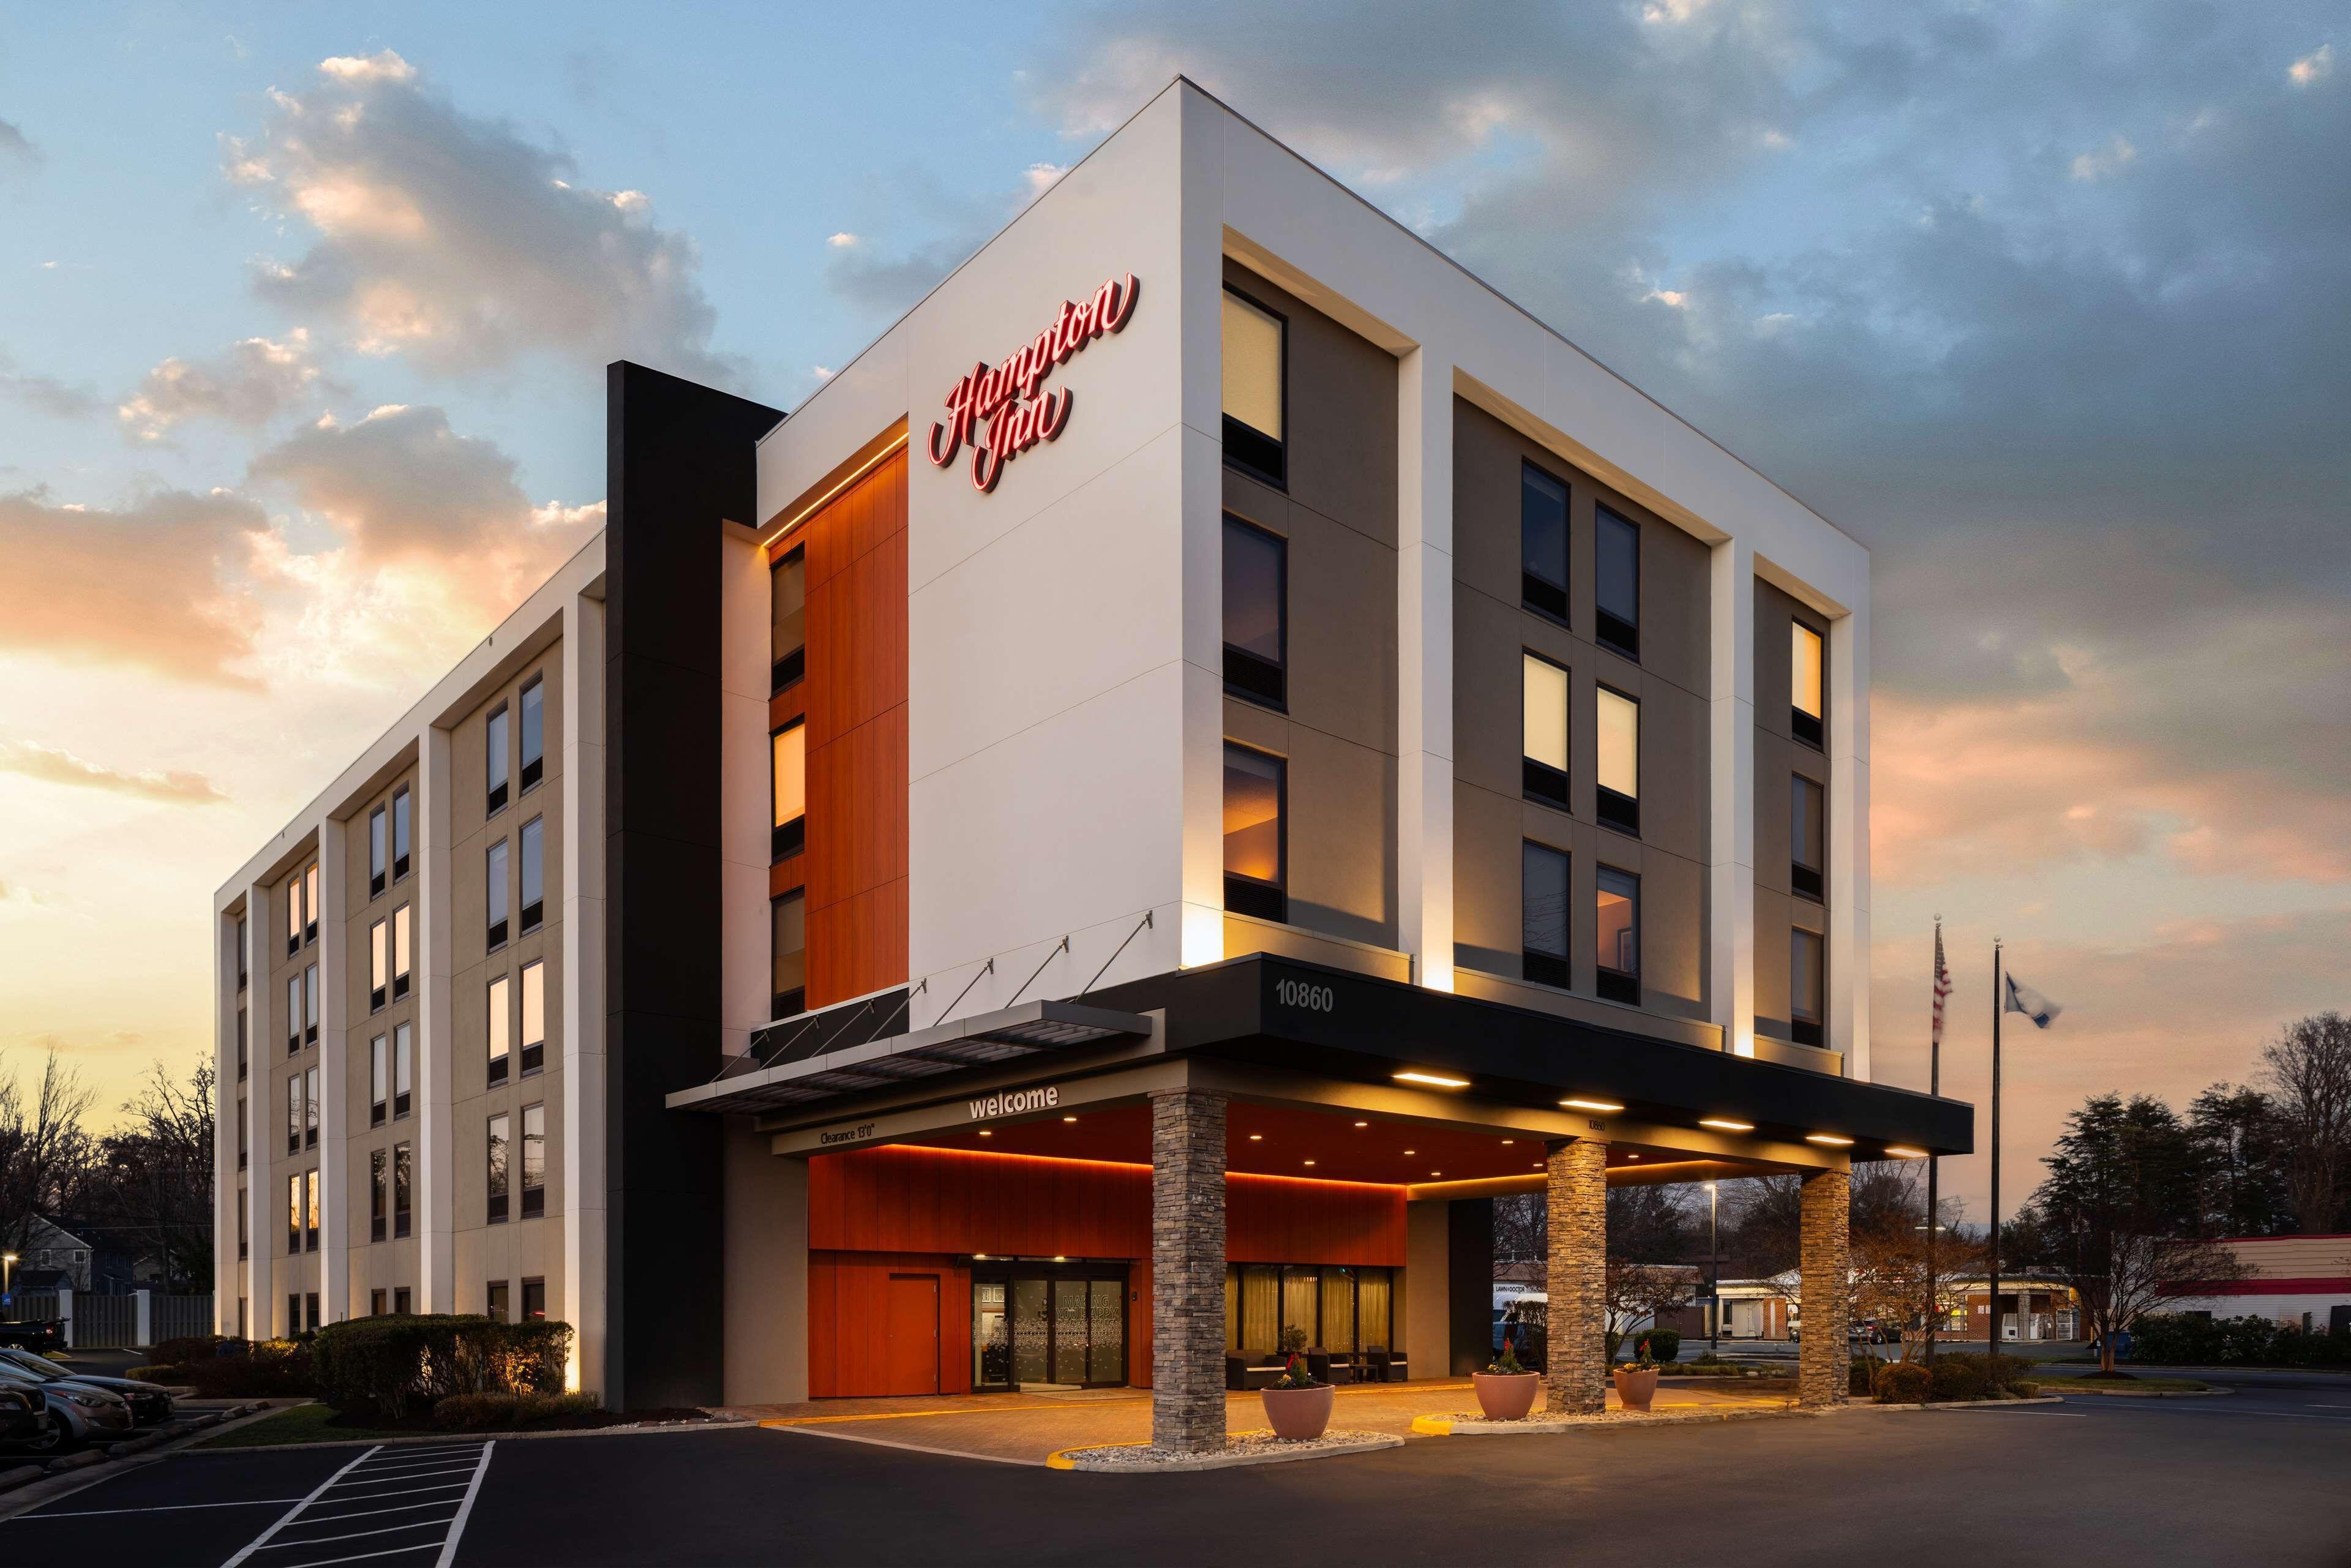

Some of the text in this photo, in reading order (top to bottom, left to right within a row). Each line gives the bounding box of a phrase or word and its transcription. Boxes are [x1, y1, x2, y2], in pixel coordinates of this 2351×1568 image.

[928, 272, 1141, 468] Hampton
[971, 384, 1073, 493] Inn
[1276, 978, 1333, 1012] 10860
[969, 1087, 1059, 1119] welcome
[821, 1131, 855, 1144] Clearance
[1056, 1307, 1078, 1320] YOU
[1063, 1294, 1109, 1308] MAKNG
